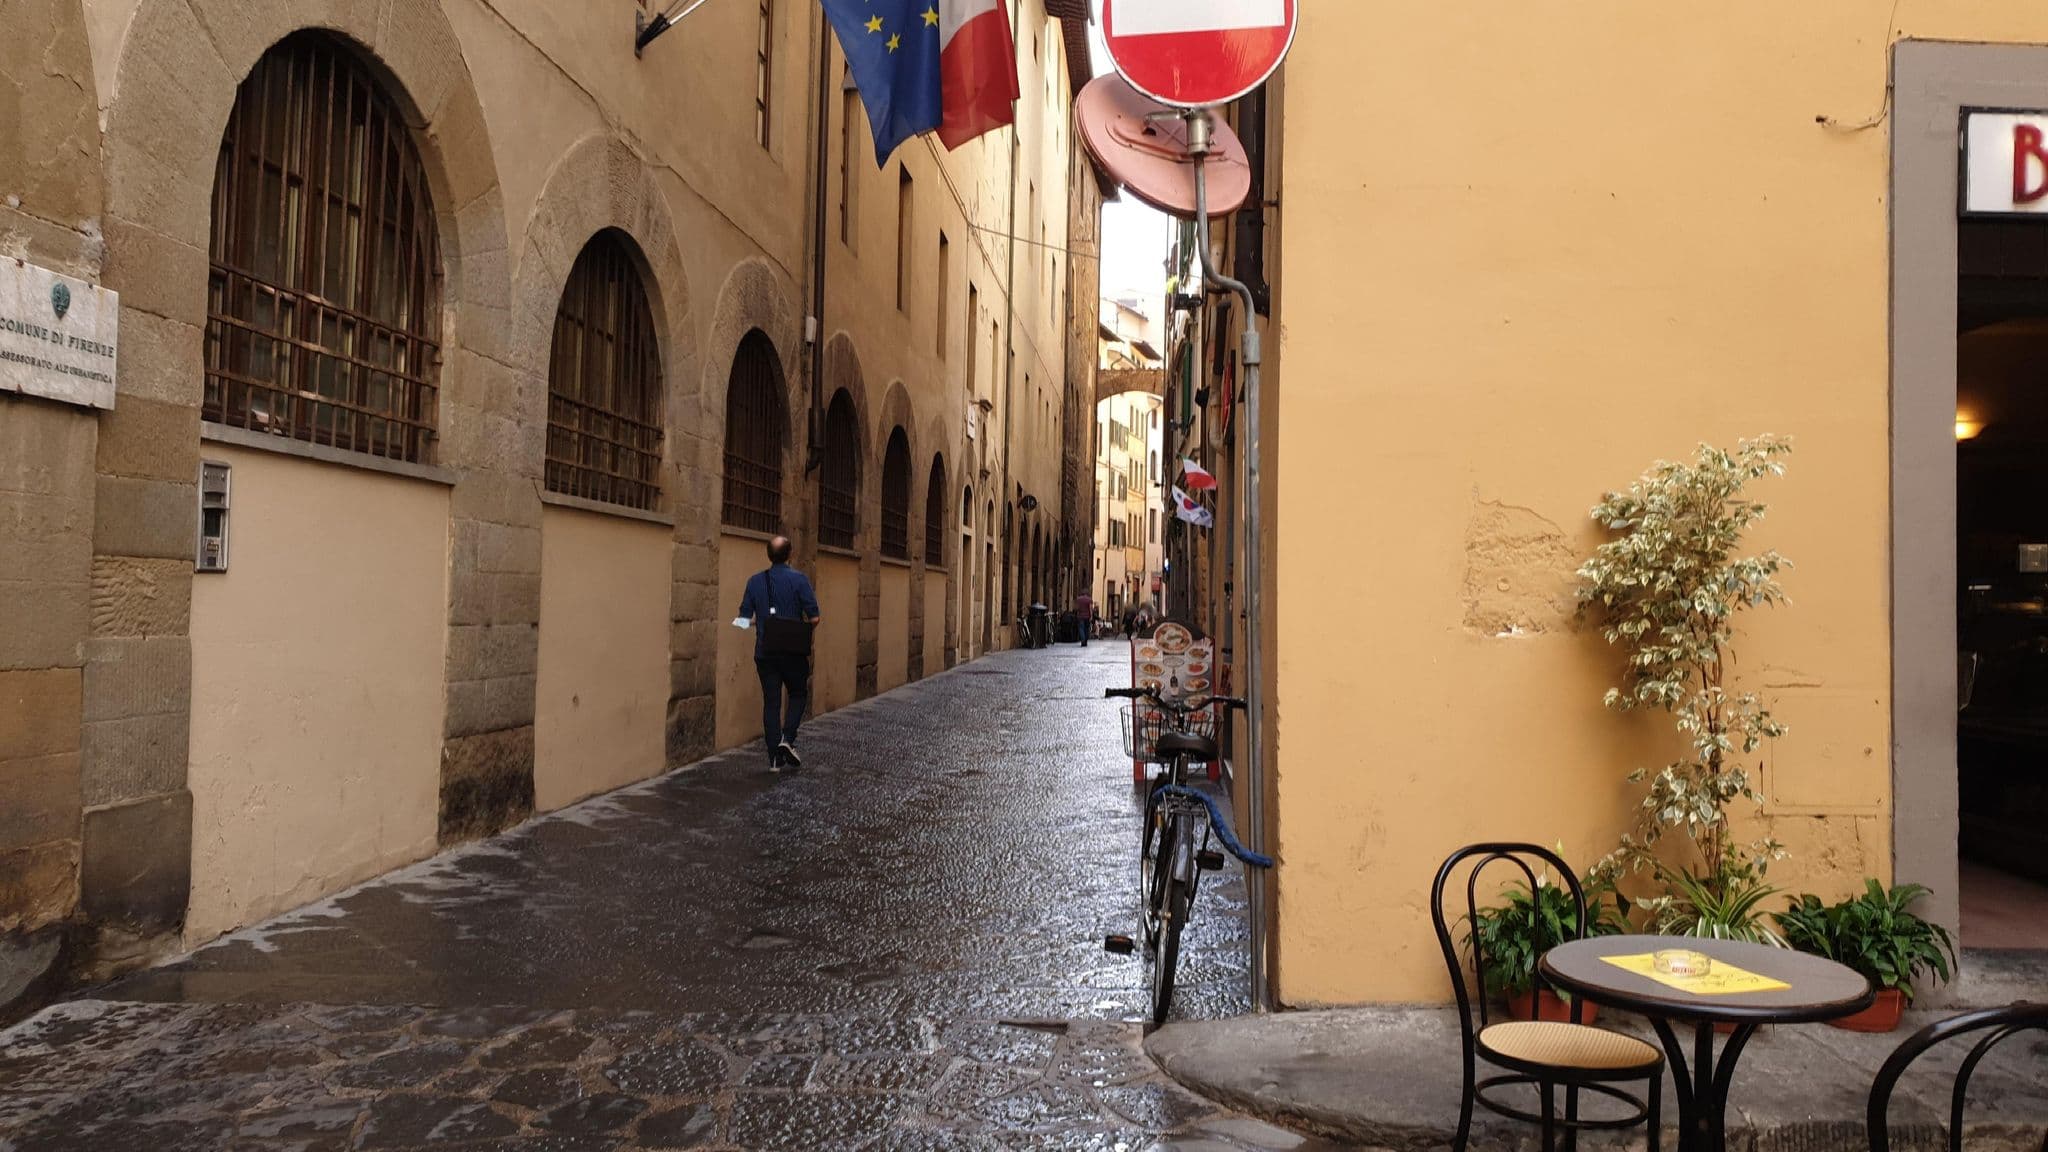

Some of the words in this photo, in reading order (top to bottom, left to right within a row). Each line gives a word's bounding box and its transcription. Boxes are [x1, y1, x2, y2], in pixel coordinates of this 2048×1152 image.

[0, 317, 48, 341] COMUNE
[51, 331, 64, 346] DI
[68, 335, 115, 358] FIRENZE
[0, 350, 52, 370] SSESSORATO
